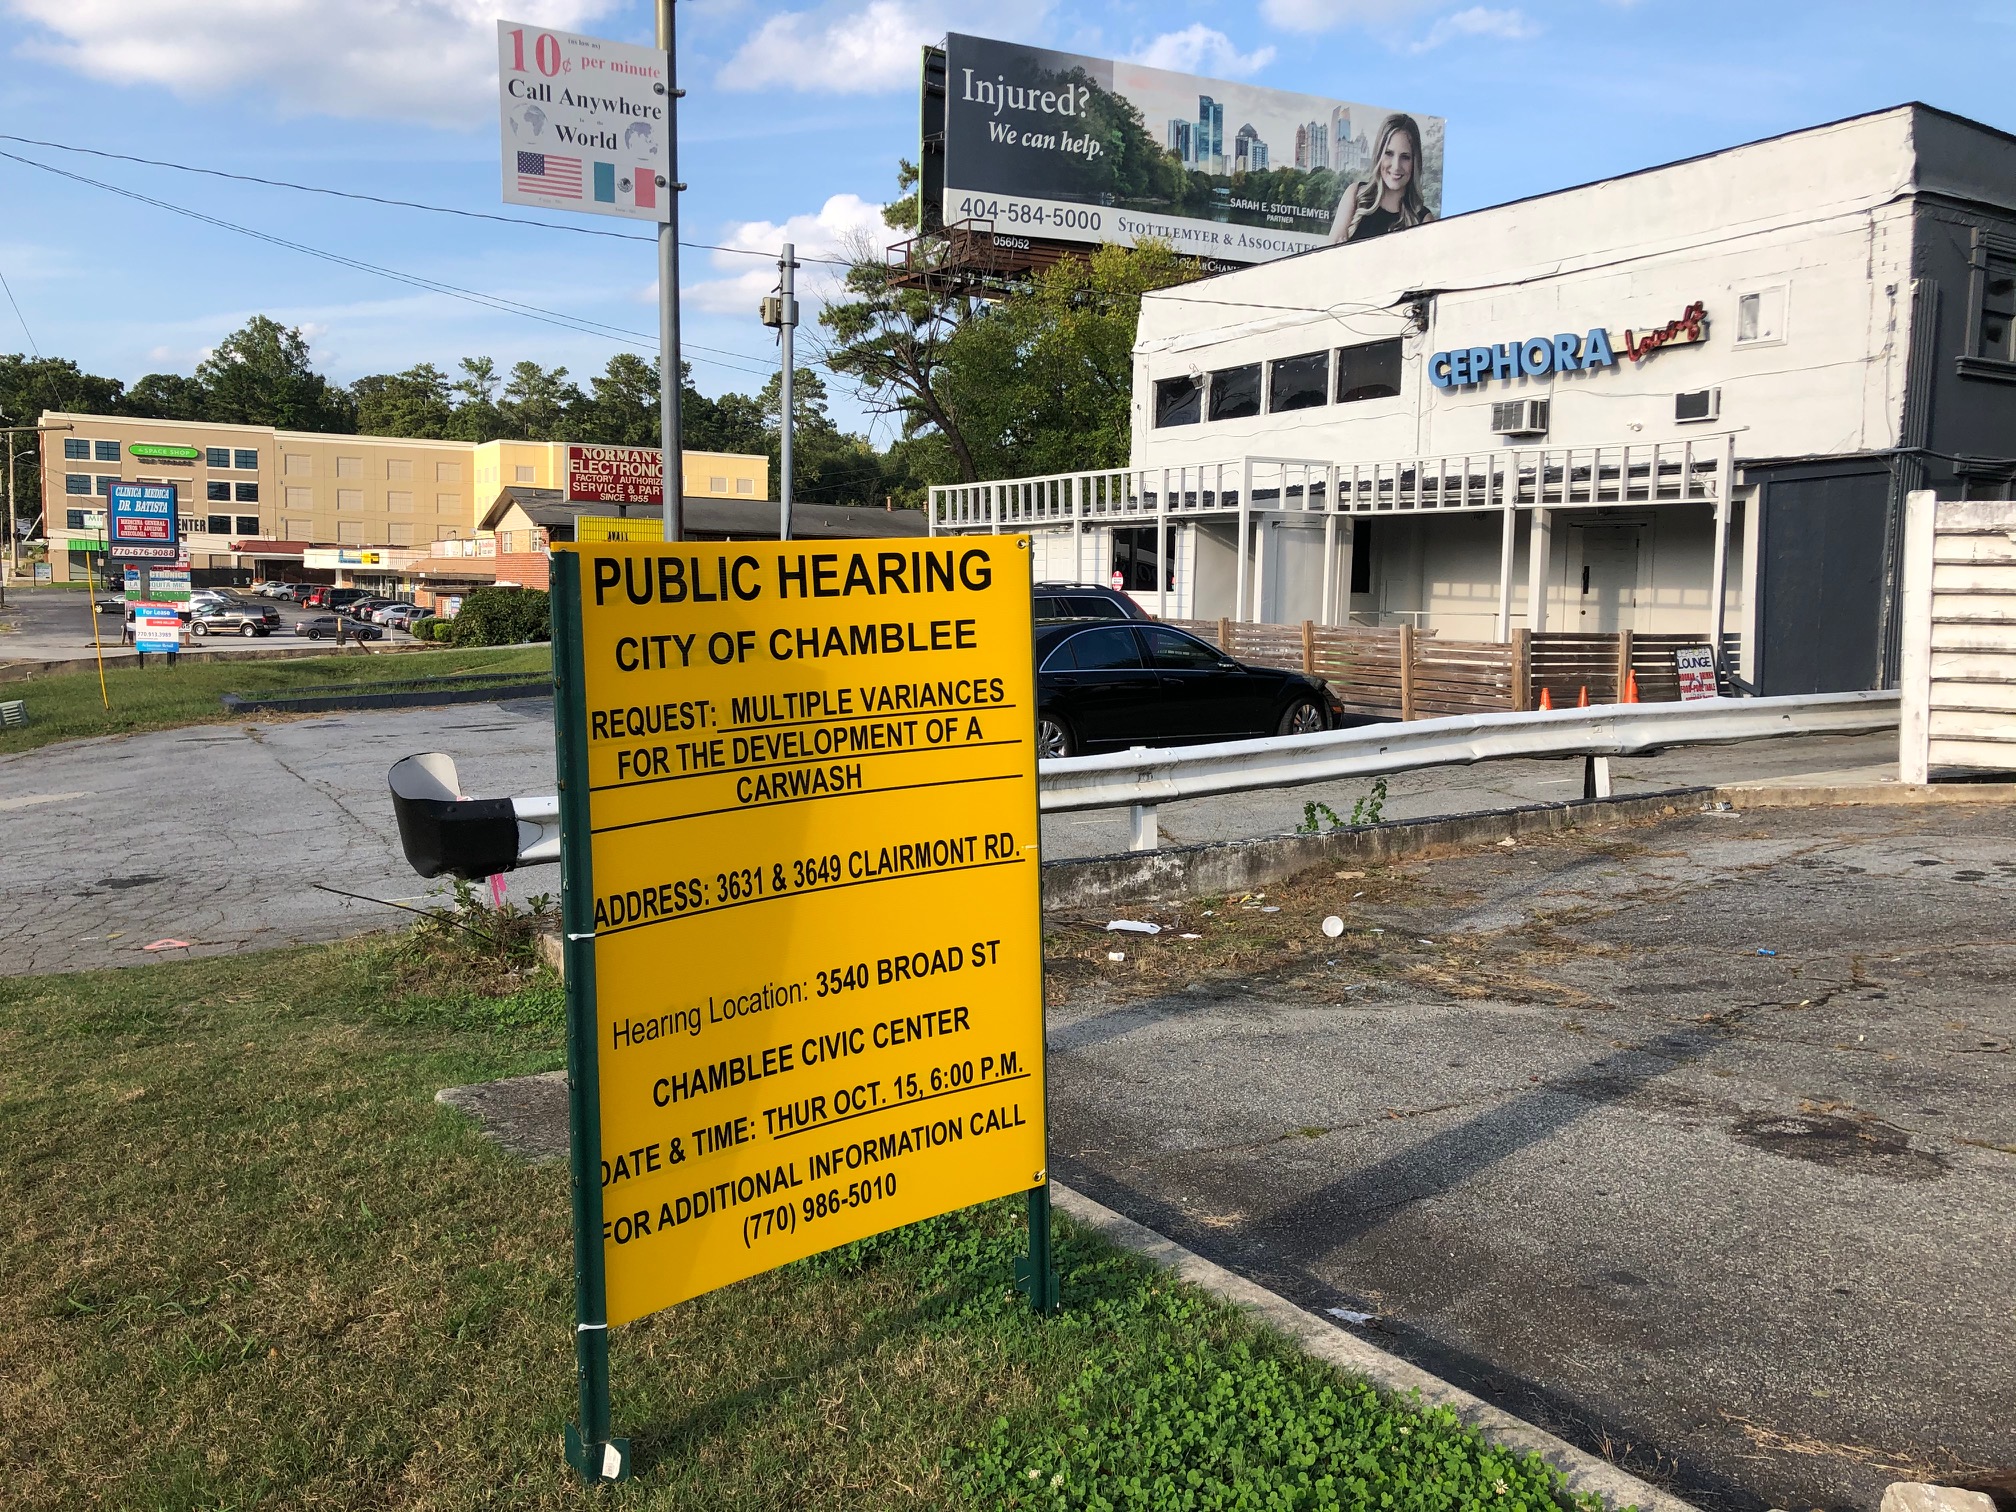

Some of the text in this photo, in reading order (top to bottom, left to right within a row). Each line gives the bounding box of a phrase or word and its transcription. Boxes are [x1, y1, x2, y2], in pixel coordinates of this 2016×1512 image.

[581, 56, 605, 70] per
[611, 61, 660, 78] minute
[508, 79, 662, 120] Call Anywhere
[962, 68, 1090, 118] Injured?
[555, 124, 617, 150] World
[989, 121, 1103, 161] We can help.
[960, 197, 1101, 231] 404-584-5000
[1230, 197, 1330, 220] SARAH E. STOTTLEMYER
[1266, 215, 1293, 223] PARTNER
[993, 236, 1030, 249] 056052
[1223, 233, 1233, 246] &
[1428, 327, 1613, 388] CEPHORA
[582, 448, 663, 464] NORMAN'S
[115, 486, 169, 499] CLINICA MEDICA
[572, 482, 623, 494] SERVICE
[628, 485, 635, 494] &
[575, 474, 614, 483] FACTORY
[118, 500, 168, 513] DR. BATISTA
[600, 493, 649, 503] SINCE 1955
[113, 548, 174, 556] 770-676-9088
[594, 549, 993, 606] PUBLIC HEARING
[615, 619, 977, 672] CITY OF CHAMBLEE
[1678, 657, 1712, 669] LOUNGE
[591, 677, 1005, 741] REQUEST: MULTIPLE VARIANCES
[618, 716, 983, 780] FOR THE DEVELOPMENT OF A
[736, 763, 863, 804] CARWASH
[593, 832, 1021, 930] ADDRESS: 3631 & 3649 CLAIRMONT RD.
[612, 939, 1001, 1050] Hearing Location: 3540 BROAD ST
[652, 1006, 971, 1108] CHAMBLEE CIVIC CENTER
[601, 1051, 1024, 1188] DATE & TIME: THUR OCT. 15, 6:00 P.M.
[657, 1161, 803, 1231] ADDITIONAL
[809, 1113, 963, 1182] INFORMATION
[970, 1103, 1027, 1137] CALL
[743, 1172, 897, 1249] (770) 986-5010
